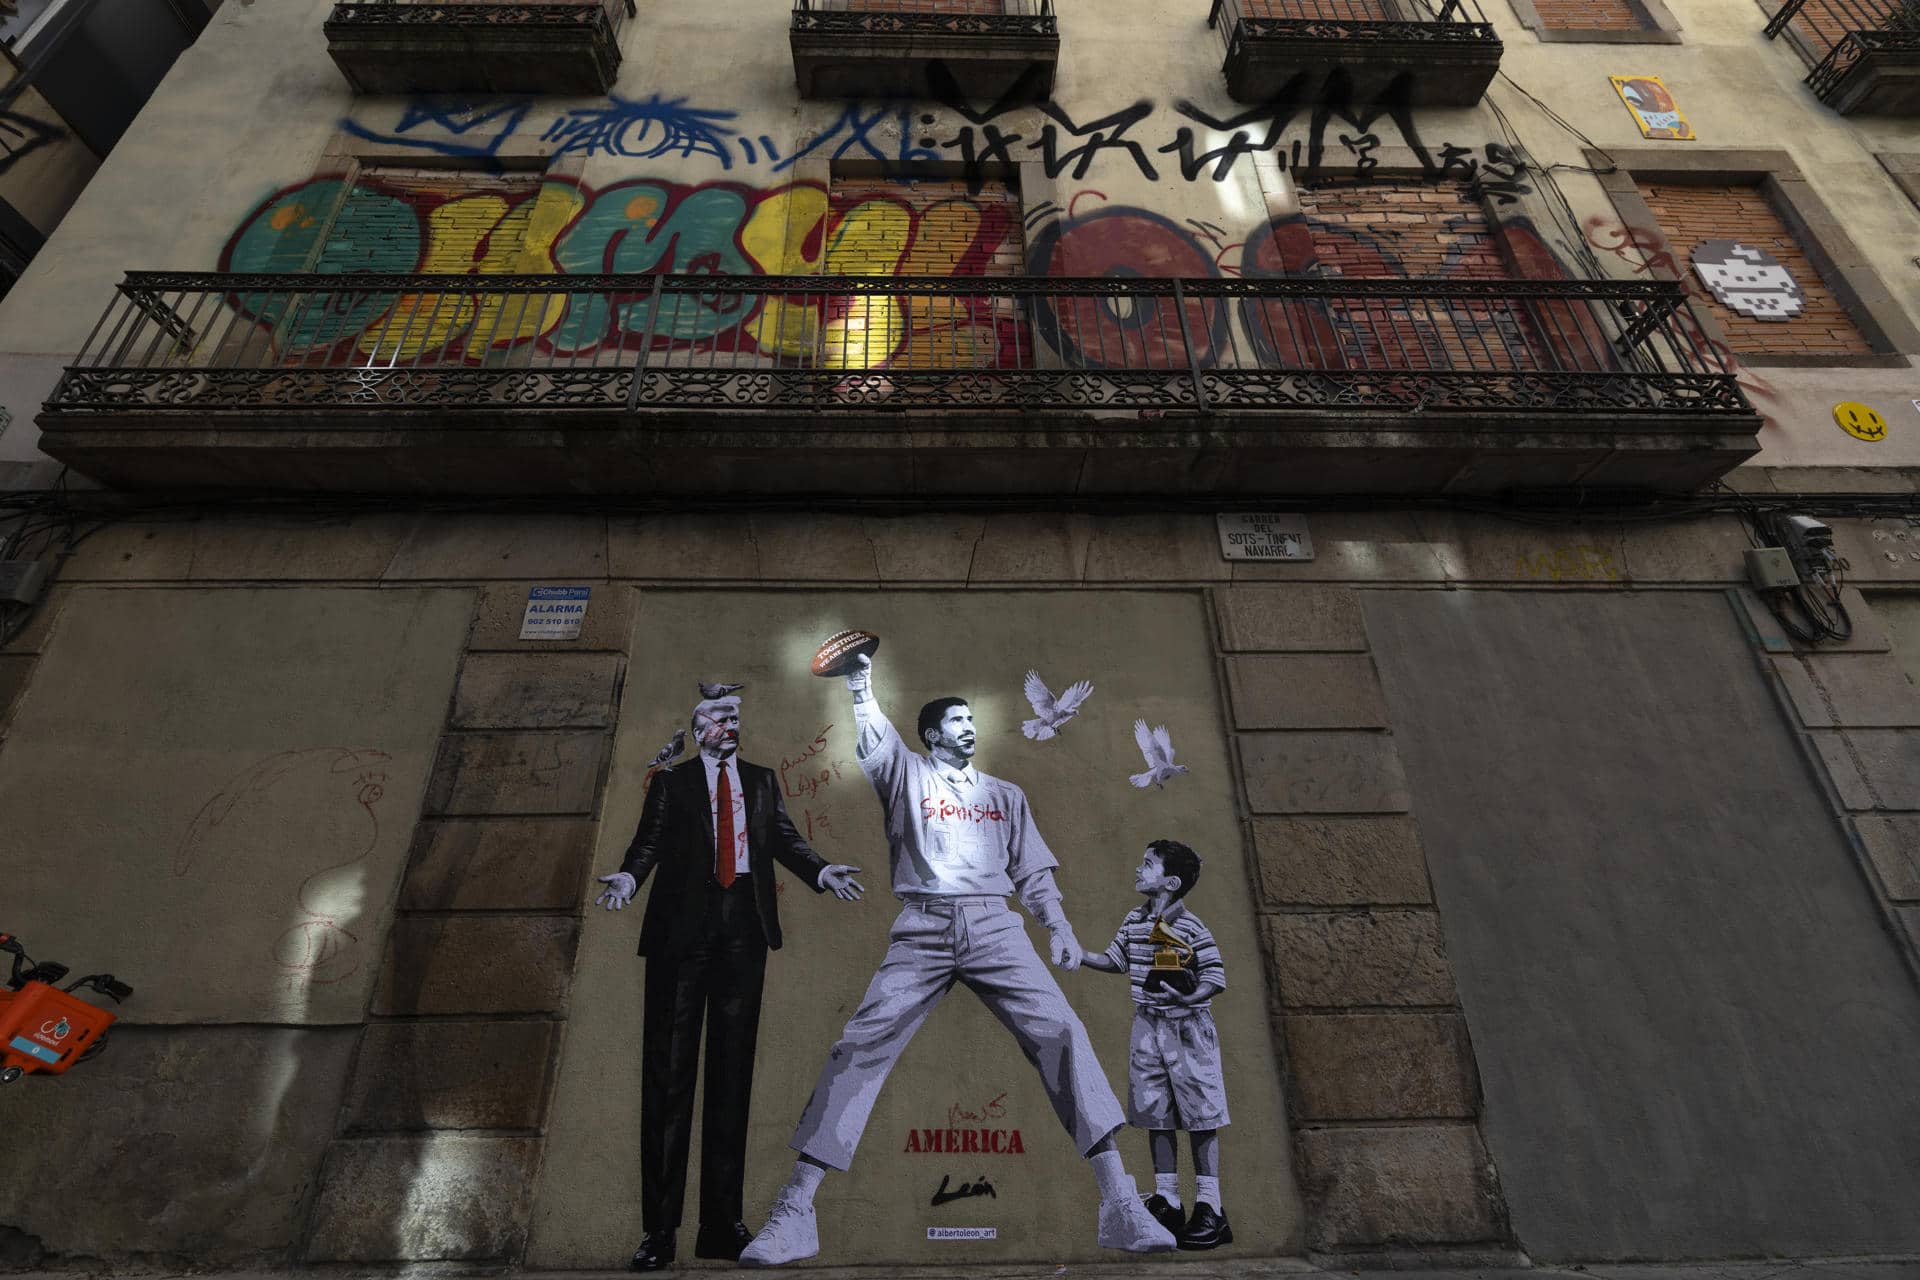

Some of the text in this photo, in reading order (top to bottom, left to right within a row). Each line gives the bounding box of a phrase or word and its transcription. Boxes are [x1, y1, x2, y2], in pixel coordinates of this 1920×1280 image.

[1254, 524, 1273, 533] DEL
[530, 605, 583, 613] ALARMA
[819, 658, 830, 668] WE
[829, 649, 843, 661] ARE
[904, 1128, 1025, 1154] AMERICA
